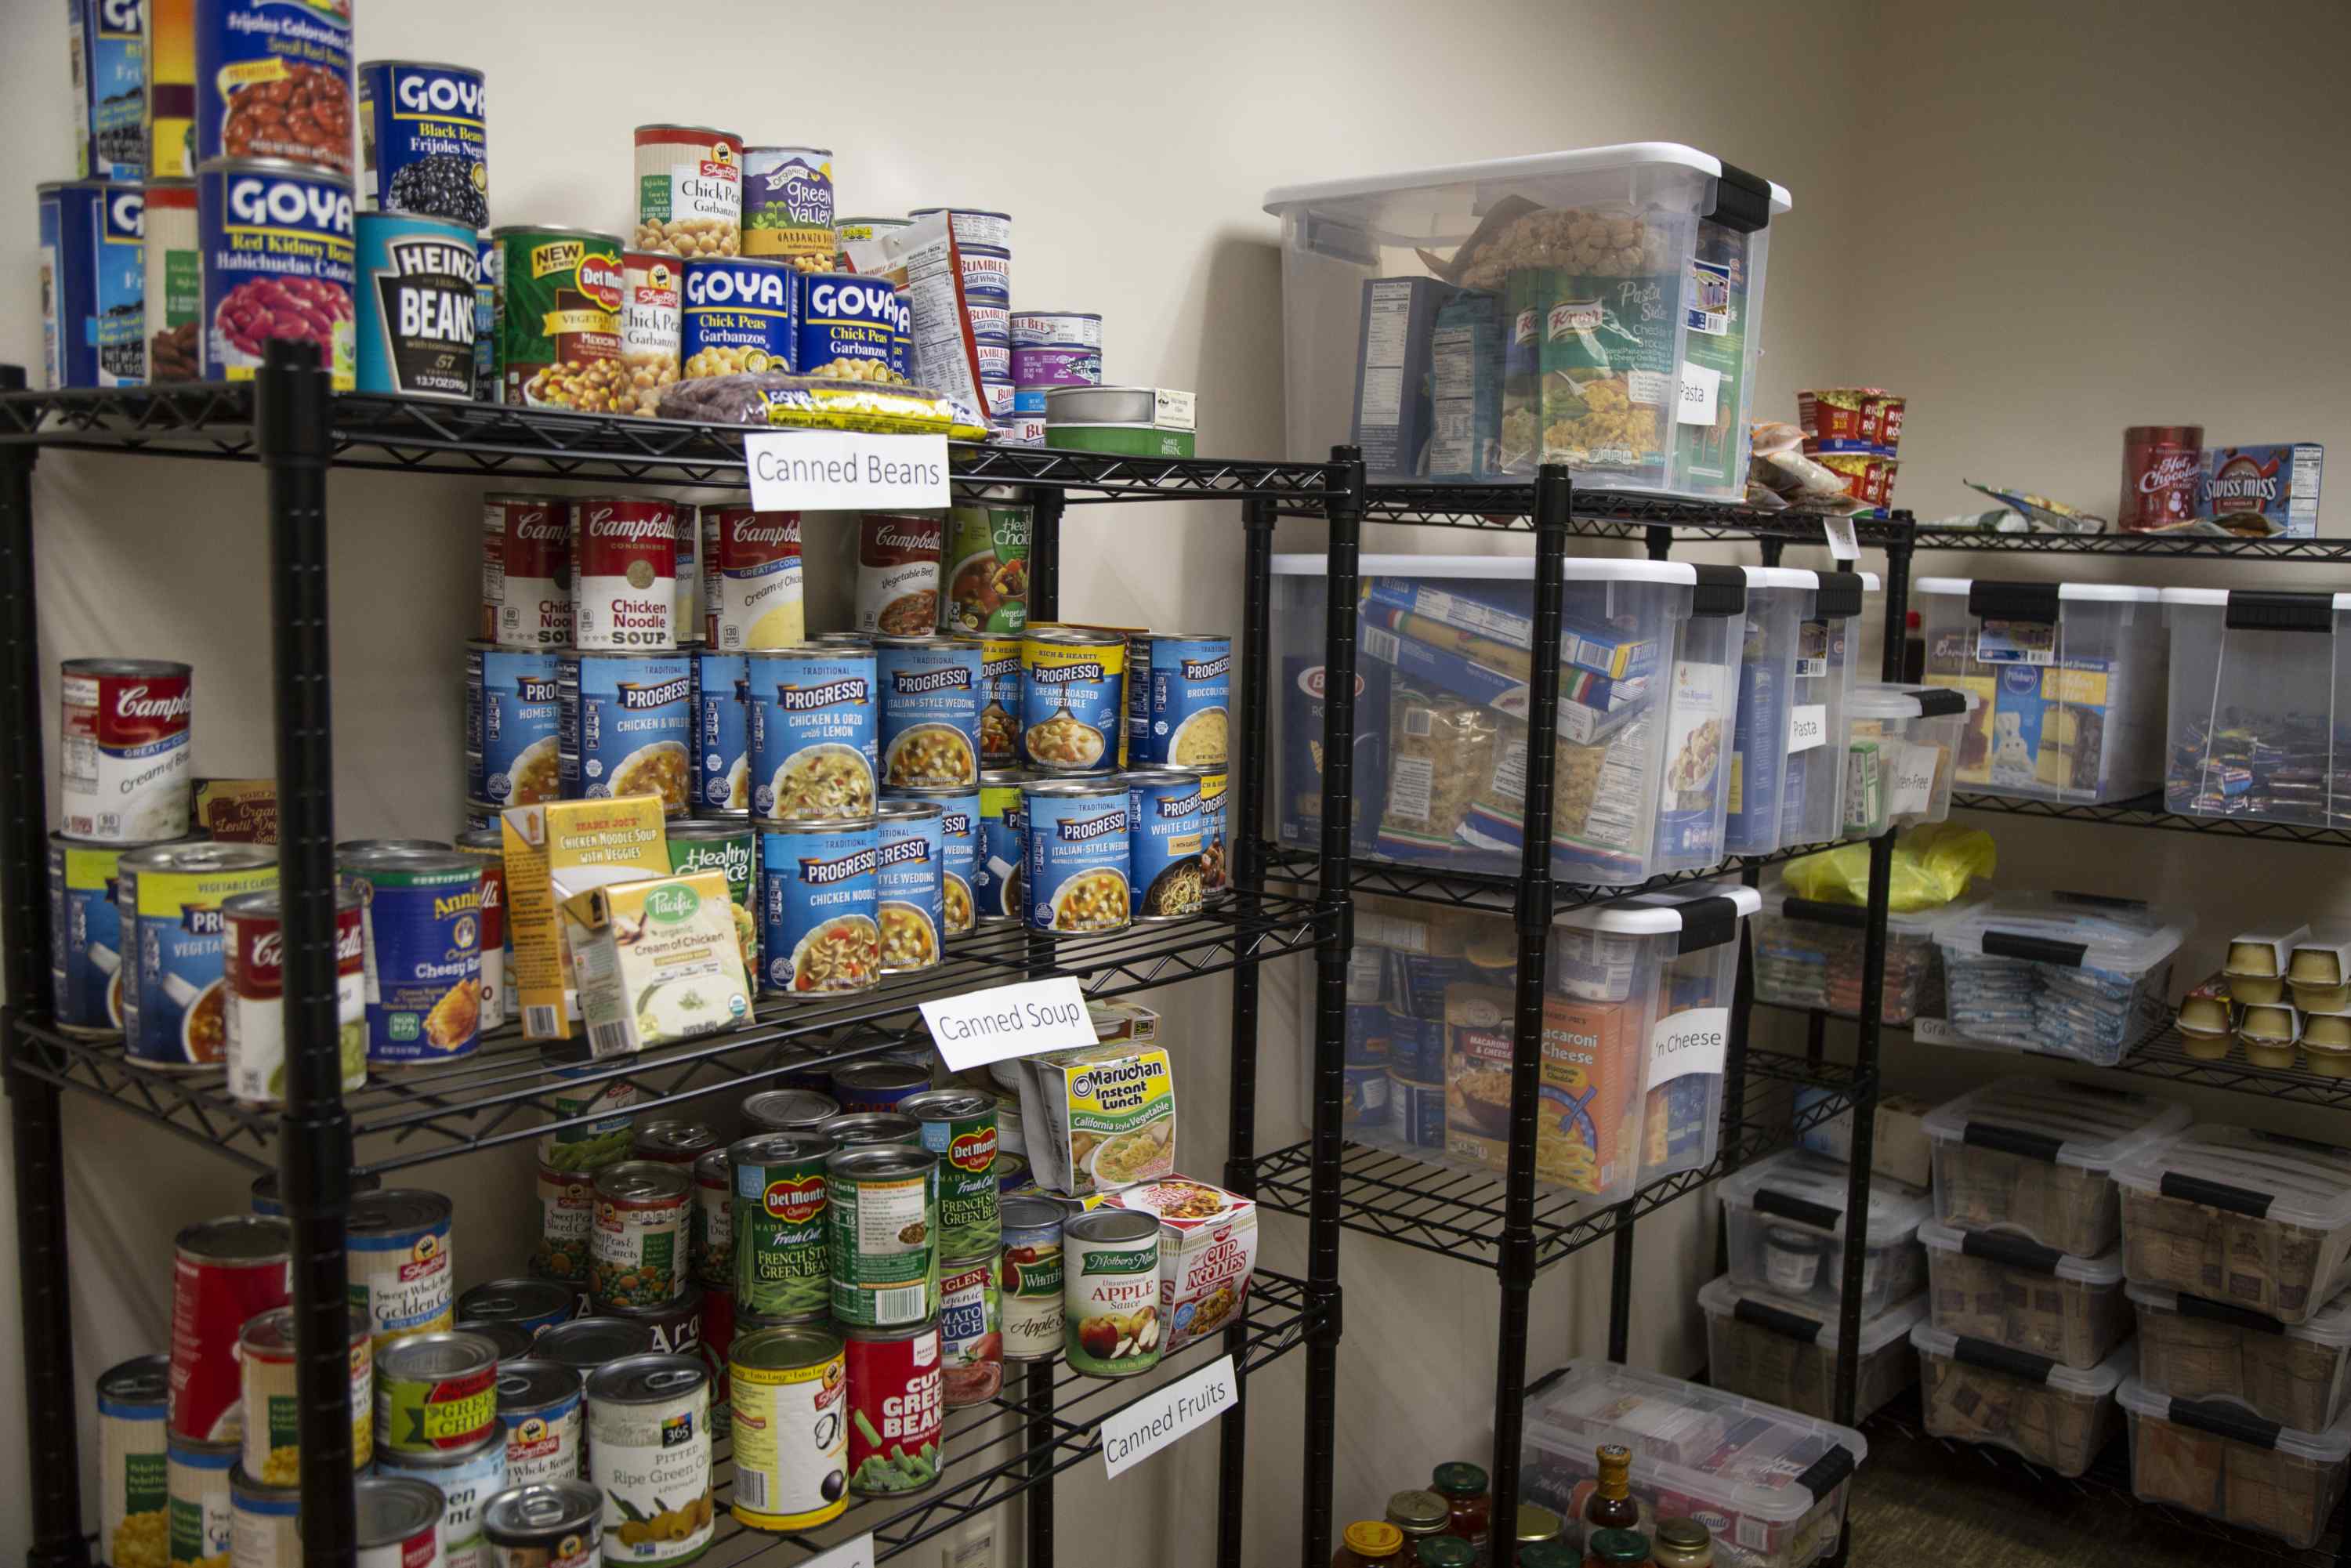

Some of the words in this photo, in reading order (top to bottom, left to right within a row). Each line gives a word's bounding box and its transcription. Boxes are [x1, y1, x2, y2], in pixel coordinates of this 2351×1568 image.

[419, 123, 455, 139] Black
[410, 137, 460, 155] Frijoles
[682, 180, 723, 201] Chick
[231, 179, 353, 235] GOYA
[232, 234, 263, 251] Red
[269, 238, 324, 258] Kidney
[777, 234, 822, 244] GARBANZO
[536, 244, 579, 266] NEW
[216, 252, 312, 275] Habichuelas
[400, 246, 476, 281] HEINZ
[583, 266, 604, 284] Del
[686, 270, 783, 306] GOYA
[1617, 281, 1661, 306] Pasta
[812, 284, 895, 321] GOYA
[399, 287, 475, 344] BEANS
[699, 315, 734, 328] Chick
[738, 317, 766, 330] Peas
[971, 310, 1002, 321] BUMBLE
[1027, 319, 1045, 332] BEE
[699, 330, 766, 345] Garbanzos
[830, 327, 865, 341] Chick
[868, 328, 888, 343] Peas
[830, 342, 887, 358] Garbanzos
[1679, 381, 1704, 403] Pasta
[756, 451, 857, 483] Canned
[868, 454, 940, 486] Beans
[2159, 457, 2188, 473] Hot
[740, 566, 768, 578] GREAT
[882, 570, 920, 588] Vegetable
[920, 567, 934, 578] Beef
[744, 585, 776, 607] Cream
[611, 599, 667, 614] Chicken
[613, 614, 666, 628] Noodle
[1009, 618, 1021, 628] Beef
[611, 632, 667, 645] SOUP
[725, 628, 737, 637] 130
[913, 657, 955, 665] TRADITIONAL
[802, 666, 850, 675] TRADITIONAL
[1035, 664, 1099, 683] PROGRESSO
[899, 670, 967, 693] PROGRESSO
[785, 680, 864, 710] PROGRESSO
[1035, 688, 1063, 697] CREAMY
[1065, 690, 1098, 700] ROASTED
[1186, 688, 1217, 698] BROCCOLI
[887, 697, 944, 709] ITALIAN-STYLE
[945, 697, 975, 709] WEDDING
[1045, 697, 1088, 708] VEGETABLE
[617, 716, 658, 732] CHICKEN
[789, 714, 831, 726] CHICKEN
[834, 715, 839, 725] &
[843, 714, 862, 726] ORZO
[801, 727, 821, 739] with
[824, 726, 853, 738] LEMON
[1793, 719, 1817, 738] Pasta
[124, 744, 161, 757] GREAT
[120, 763, 165, 794] Cream
[1078, 802, 1116, 813] TRADITIONAL
[1063, 813, 1125, 841] PROGRESSO
[1150, 823, 1185, 835] WHITE
[560, 835, 597, 849] CHICKEN
[600, 831, 634, 846] NOODLE
[636, 829, 657, 841] SOUP
[825, 839, 867, 849] TRADITIONAL
[604, 846, 641, 860] VEGGIES
[687, 842, 751, 869] Healthy
[944, 845, 973, 855] WEDDING
[1052, 841, 1107, 856] ITALIAN-STYLE
[808, 849, 877, 883] PROGRESSO
[901, 871, 935, 884] WEDDING
[197, 880, 248, 893] VEGETABLE
[649, 891, 694, 915] Pacific
[810, 891, 850, 907] CHICKEN
[853, 889, 877, 901] NOODLE
[635, 943, 670, 956] Cream
[672, 937, 683, 951] of
[683, 932, 724, 947] Chicken
[415, 962, 465, 978] Cheesy
[940, 1009, 1023, 1041] Canned
[1030, 999, 1080, 1028] Soup
[1470, 1036, 1509, 1049] MACARONI
[1668, 1031, 1721, 1054] Cheese
[1483, 1048, 1512, 1059] CHEESE
[1541, 1041, 1593, 1065] Cheese
[1089, 1061, 1163, 1086] Maruchan
[1096, 1081, 1147, 1099] Instant
[1103, 1095, 1143, 1110] Lunch
[1074, 1117, 1114, 1130] California
[1129, 1102, 1169, 1126] Vegetable
[953, 1145, 972, 1158] Del
[969, 1154, 989, 1166] Quality
[957, 1179, 981, 1195] Fresh
[770, 1192, 791, 1207] Del
[791, 1189, 826, 1206] Monte
[941, 1197, 982, 1214] FRENCH
[787, 1204, 813, 1218] Quality
[944, 1211, 980, 1226] GREEN
[754, 1222, 783, 1232] MADE
[606, 1233, 627, 1247] Peas
[773, 1229, 801, 1246] Fresh
[758, 1251, 806, 1267] FRENCH
[1204, 1239, 1237, 1266] CUP
[1087, 1252, 1133, 1270] Mother's
[760, 1264, 802, 1280] GREEN
[1186, 1251, 1247, 1291] NOODLES
[946, 1270, 981, 1291] GLEN
[377, 1288, 408, 1301] Sweet
[410, 1280, 440, 1297] Whole
[1091, 1279, 1154, 1302] APPLE
[375, 1298, 434, 1320] Golden
[1110, 1300, 1142, 1311] Sauce
[1010, 1315, 1055, 1337] Apple
[906, 1367, 940, 1393] CUT
[1107, 1405, 1173, 1463] Canned
[1179, 1382, 1226, 1421] Fruits
[667, 1425, 690, 1441] 365
[656, 1445, 698, 1466] PITTED
[513, 1464, 547, 1480] Whole
[614, 1469, 647, 1487] Ripe
[650, 1465, 693, 1484] Green
